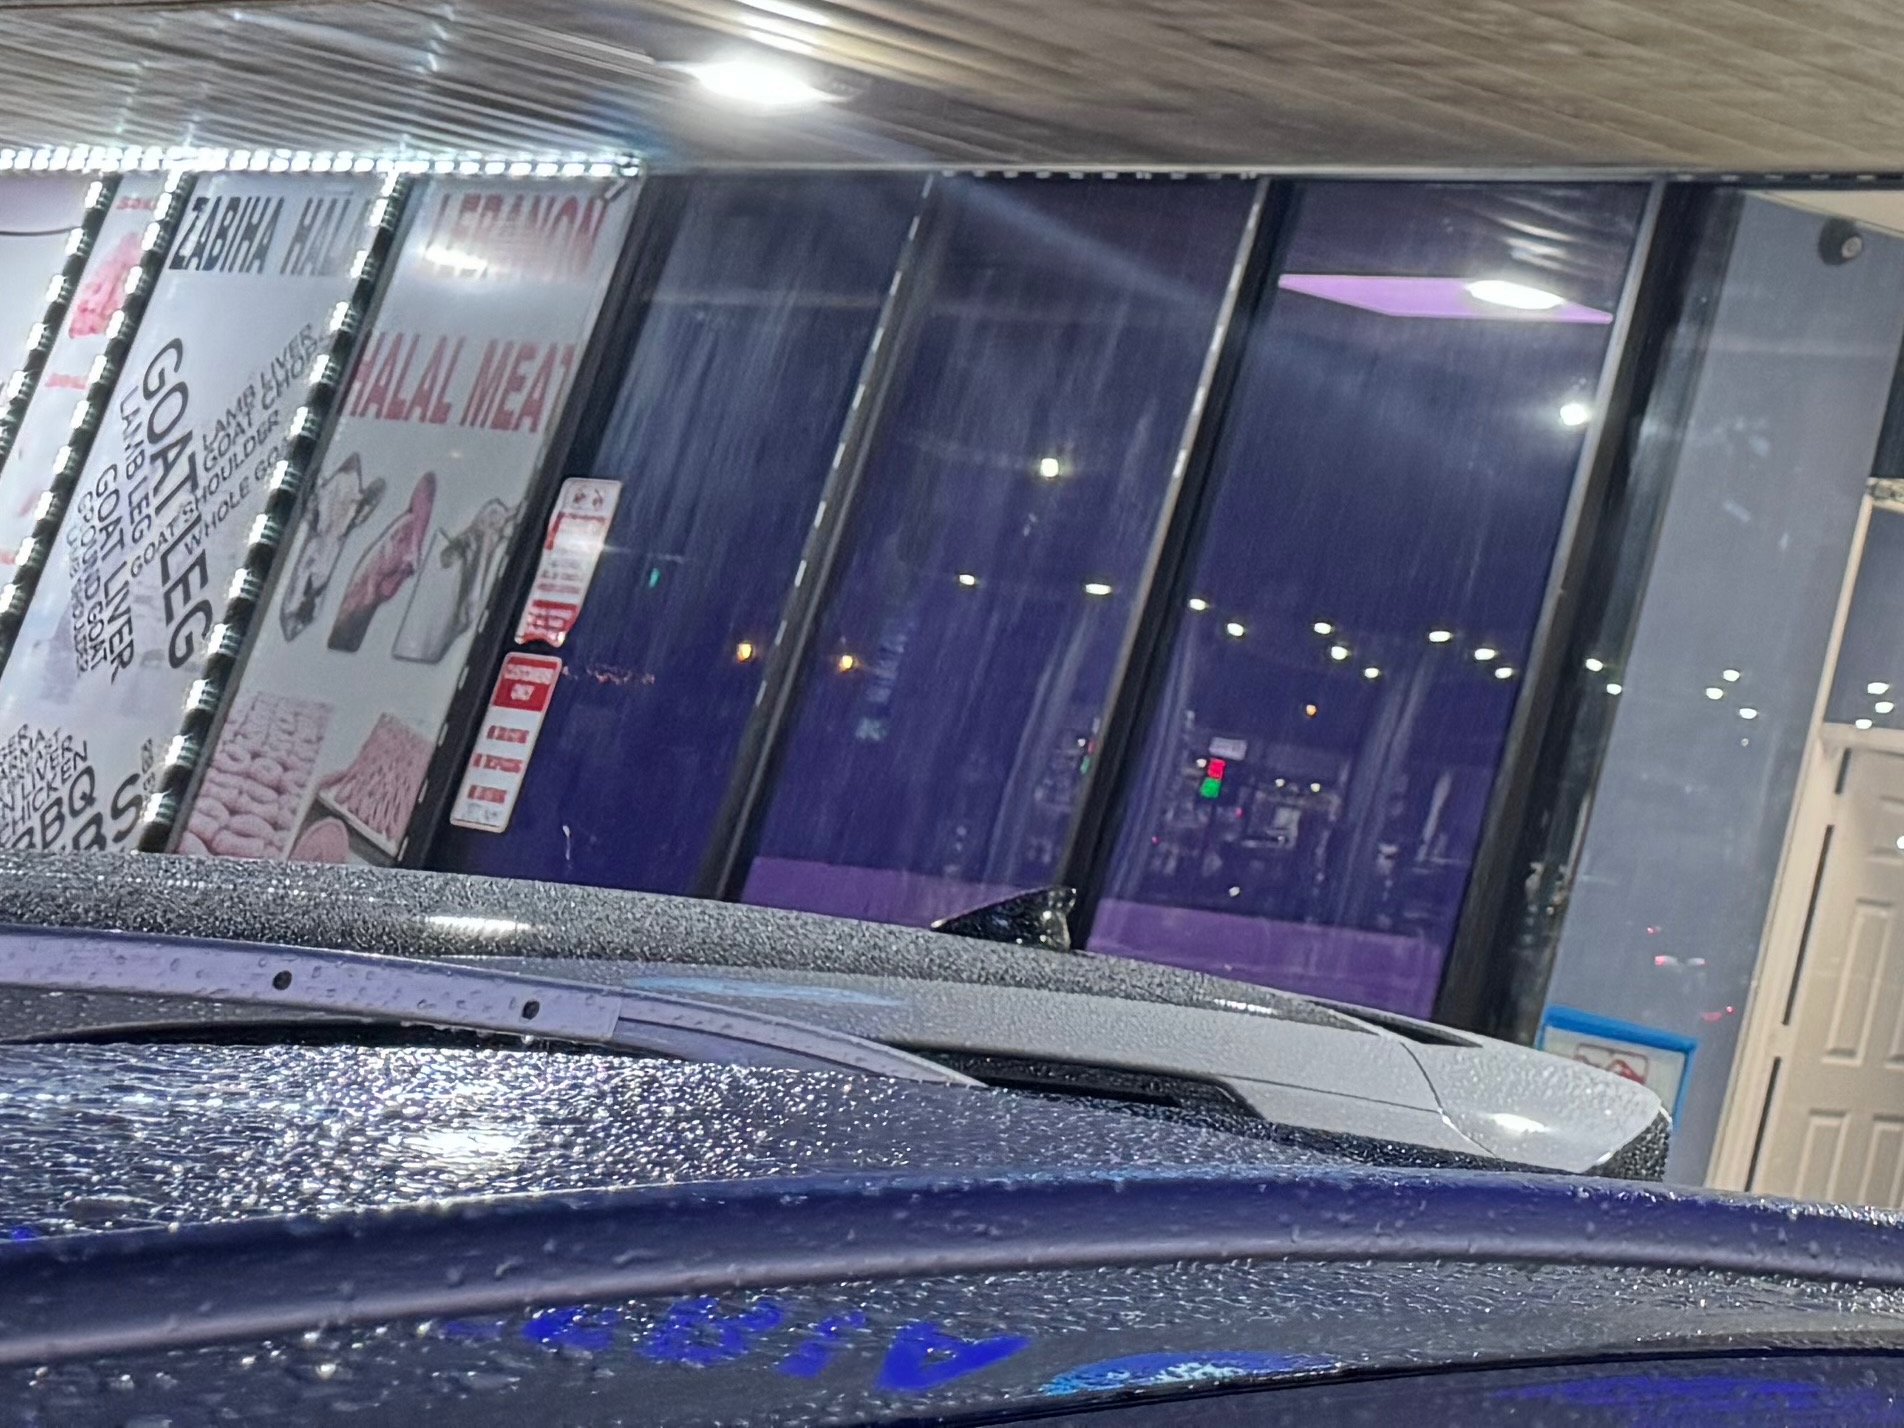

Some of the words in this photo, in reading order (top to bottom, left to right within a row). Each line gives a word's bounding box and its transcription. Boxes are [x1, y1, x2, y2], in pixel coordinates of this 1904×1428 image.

[168, 195, 285, 275] ZABIHA
[280, 196, 378, 277] HAL
[142, 337, 200, 516] GOAT
[343, 331, 463, 422] HALAL
[460, 340, 577, 434] MEAT
[95, 462, 126, 561] GOAT
[127, 475, 152, 545] LEG
[130, 515, 181, 578] GOAT
[182, 409, 280, 524] SHOULDER
[184, 475, 250, 556] WHOLE
[103, 560, 136, 686] LIVER
[160, 511, 214, 669] LEG
